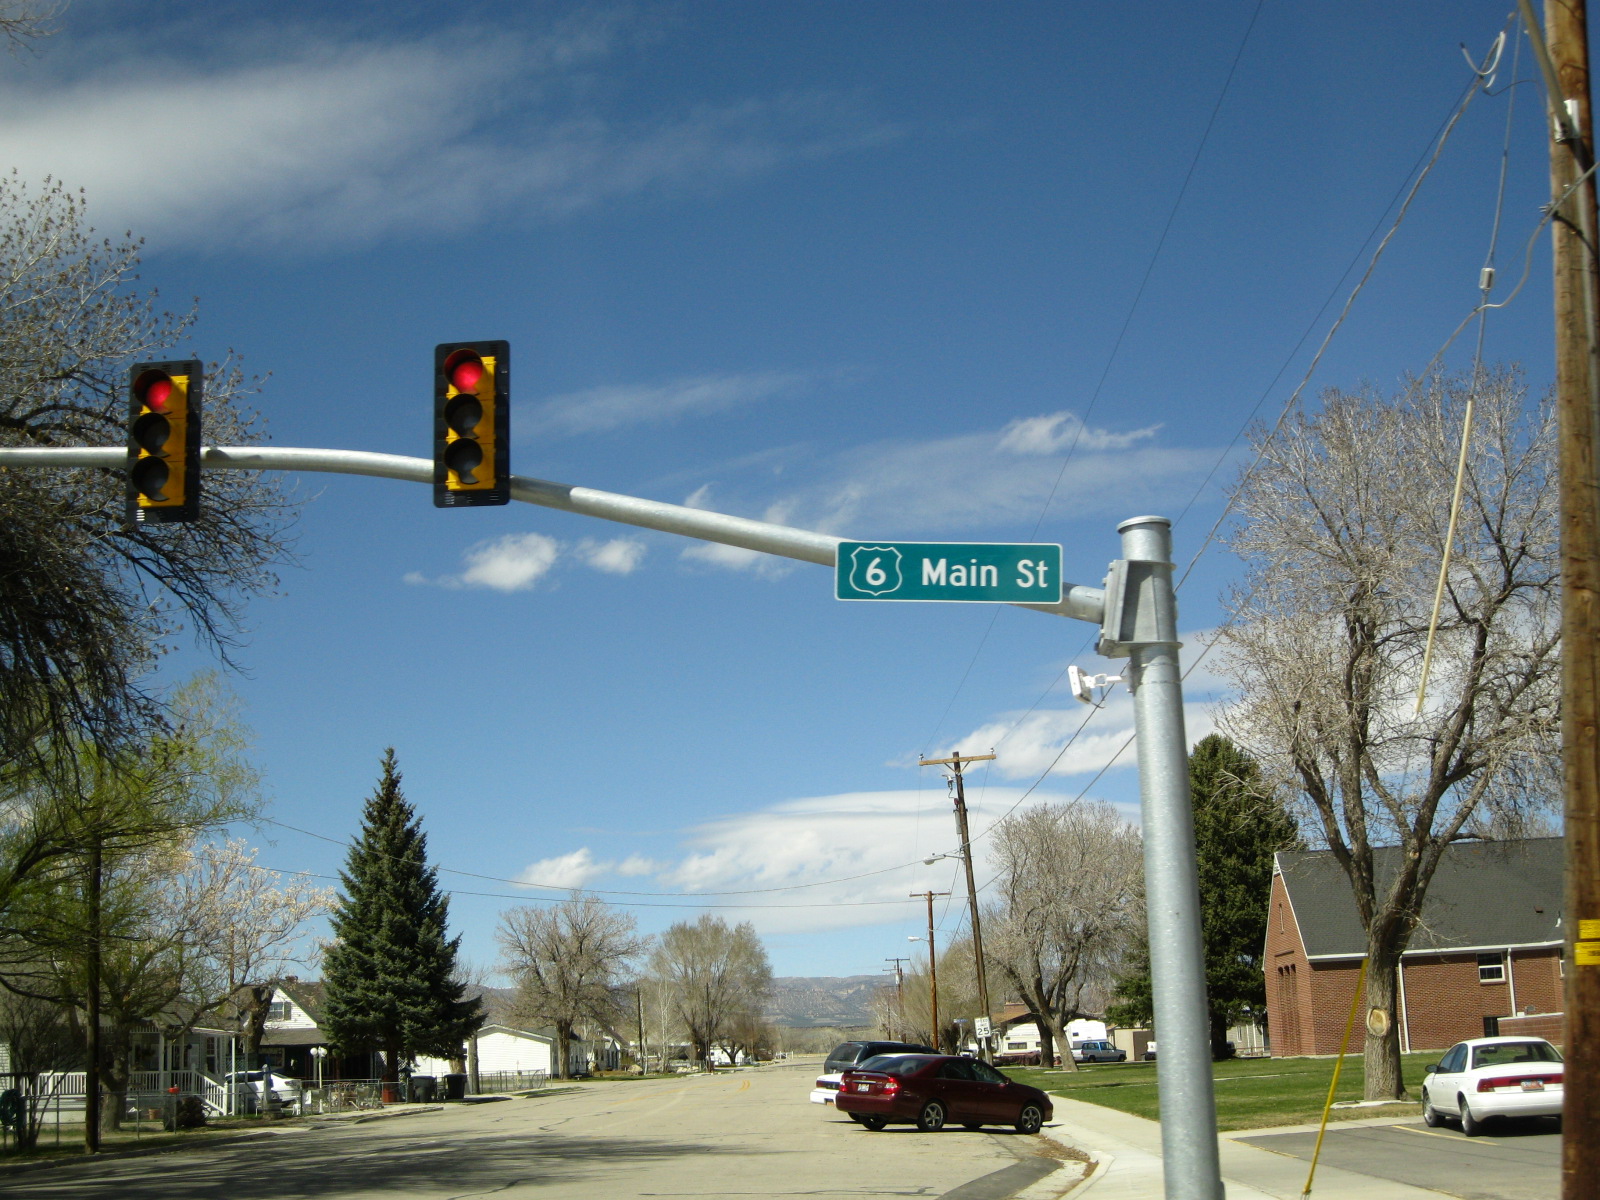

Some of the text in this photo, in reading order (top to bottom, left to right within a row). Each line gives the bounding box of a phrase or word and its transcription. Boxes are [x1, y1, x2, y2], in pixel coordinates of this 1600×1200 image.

[866, 557, 1049, 588] 6 Main St
[977, 1027, 990, 1036] 25
